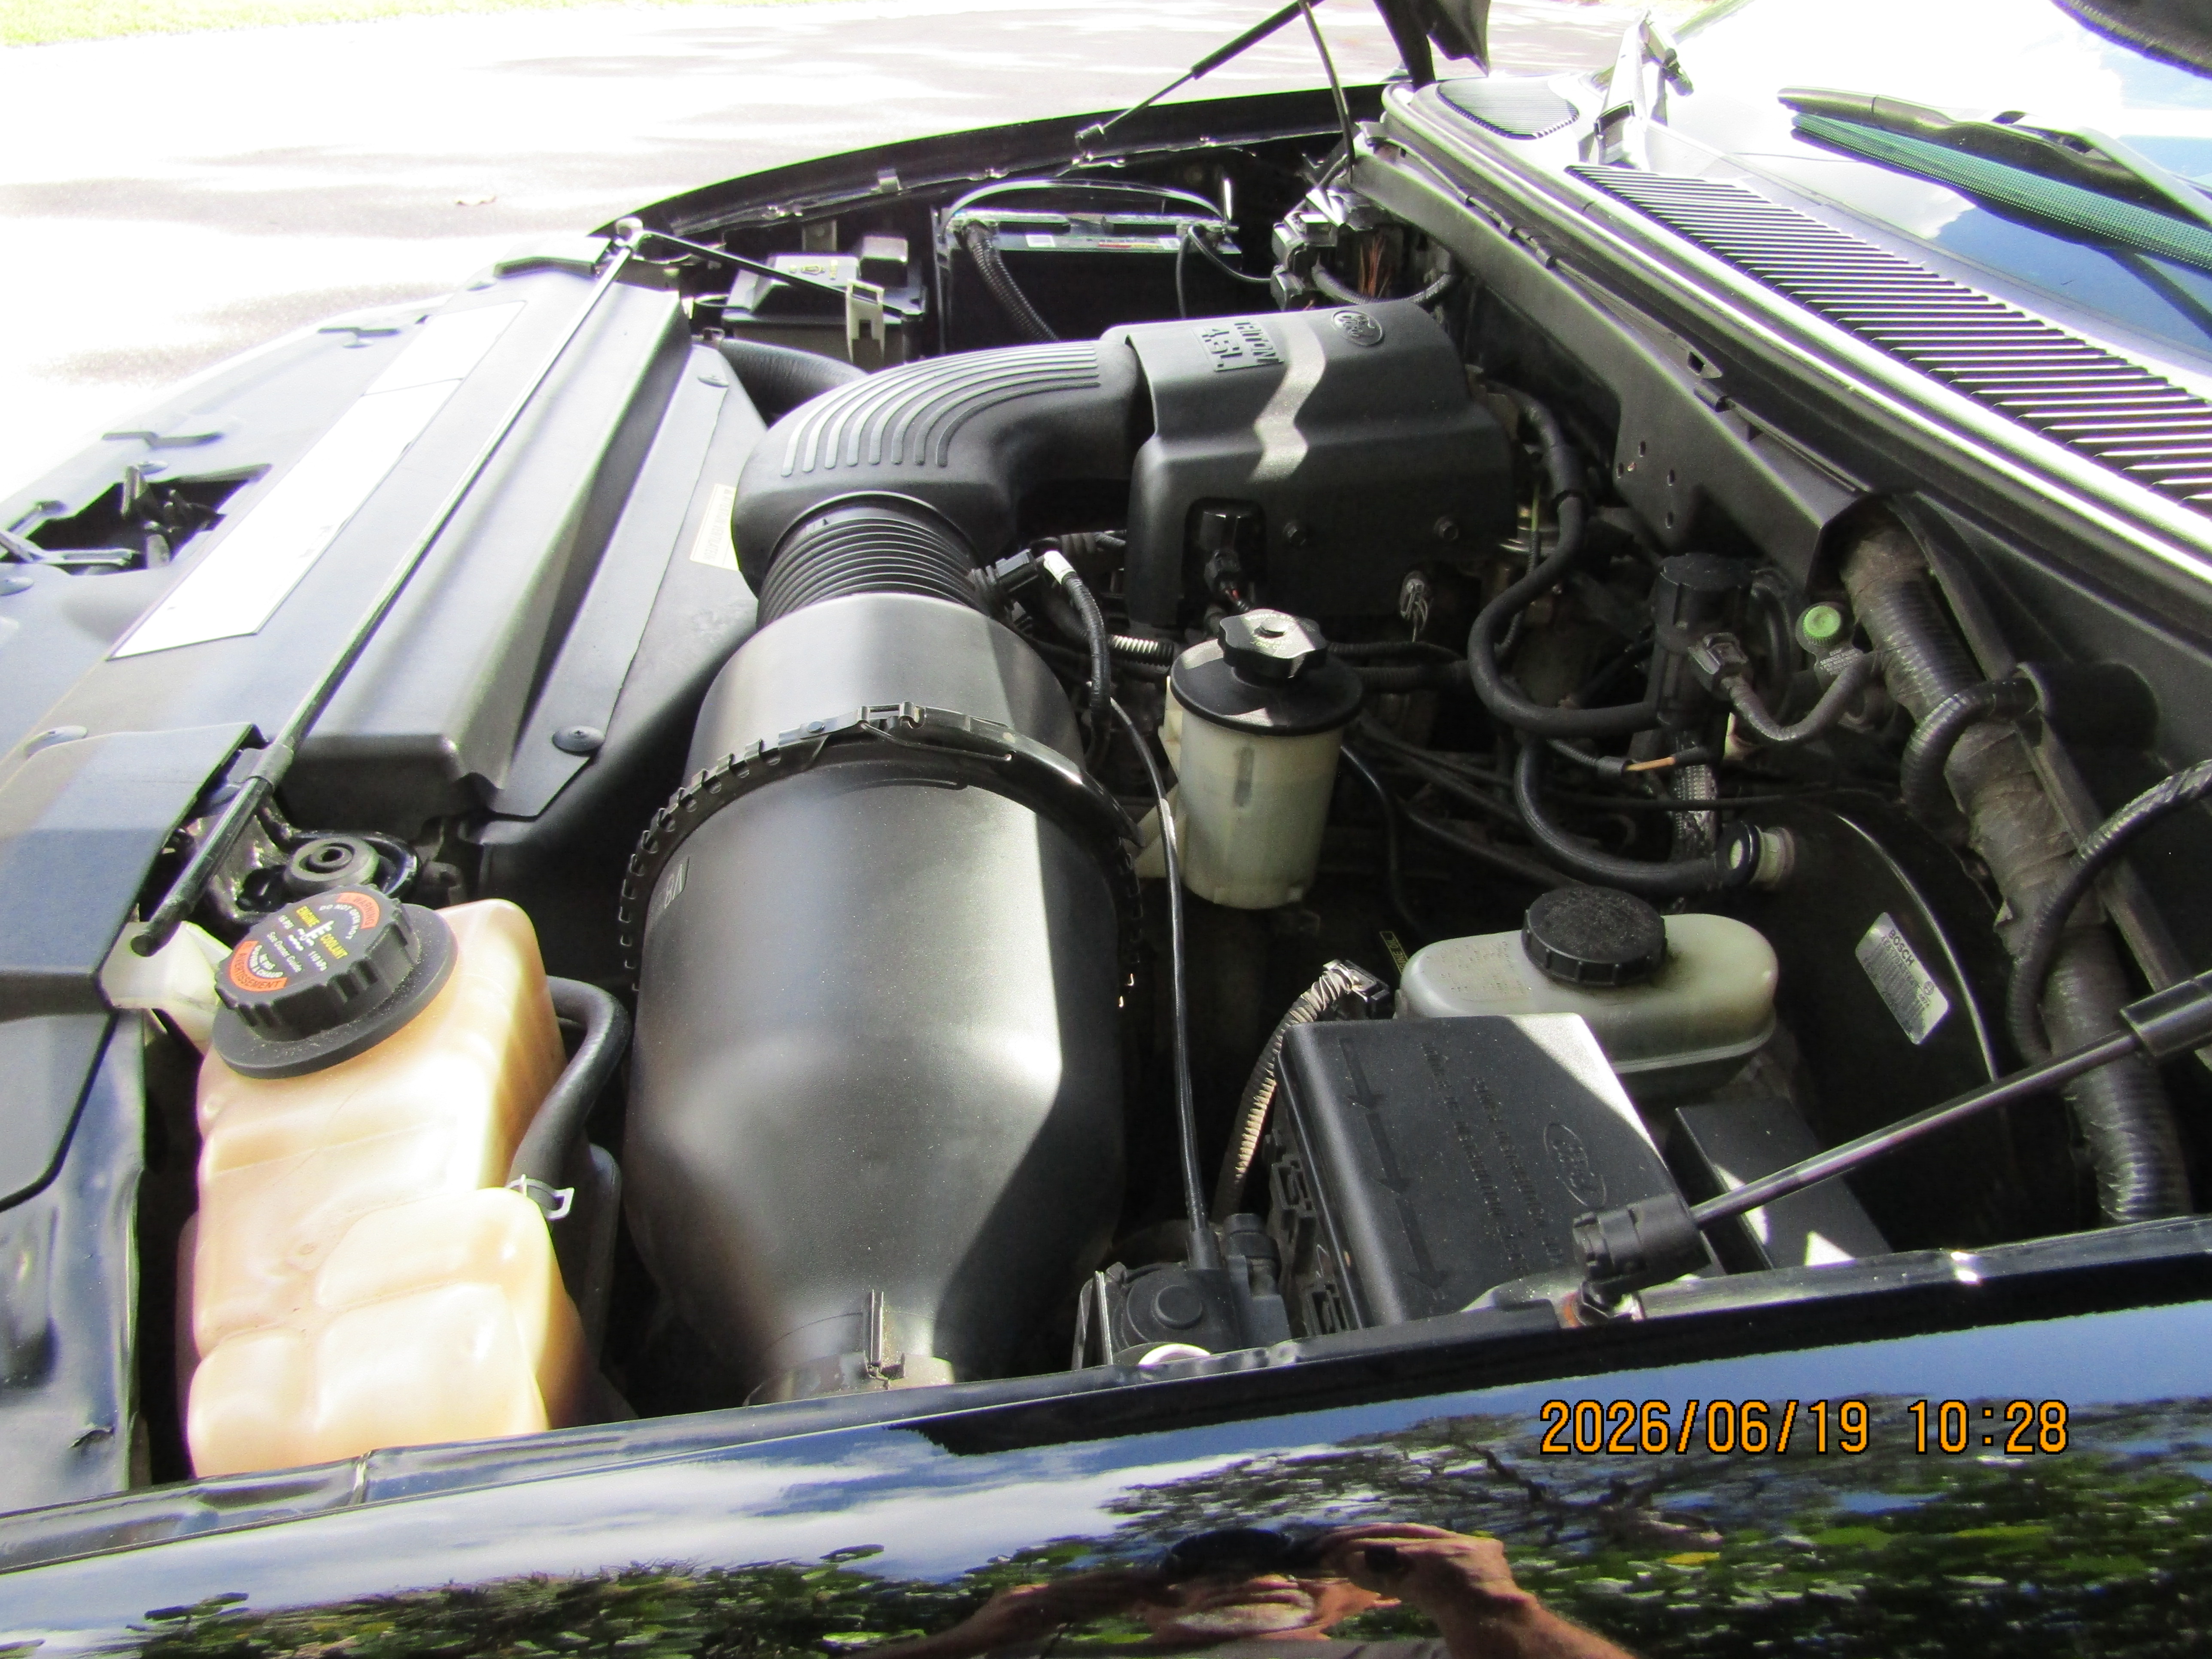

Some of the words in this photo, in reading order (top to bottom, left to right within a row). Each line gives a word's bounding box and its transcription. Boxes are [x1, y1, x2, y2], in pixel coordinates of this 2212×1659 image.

[349, 908, 361, 924] OPEN
[353, 896, 375, 925] WARNING
[296, 905, 320, 928] ENGINE
[320, 933, 349, 959] COOLANT
[1889, 929, 1915, 965] BOSCH
[266, 931, 278, 942] See
[274, 940, 290, 957] Owner
[286, 955, 303, 973] Guide
[235, 953, 280, 988] AVERTISSEMENT
